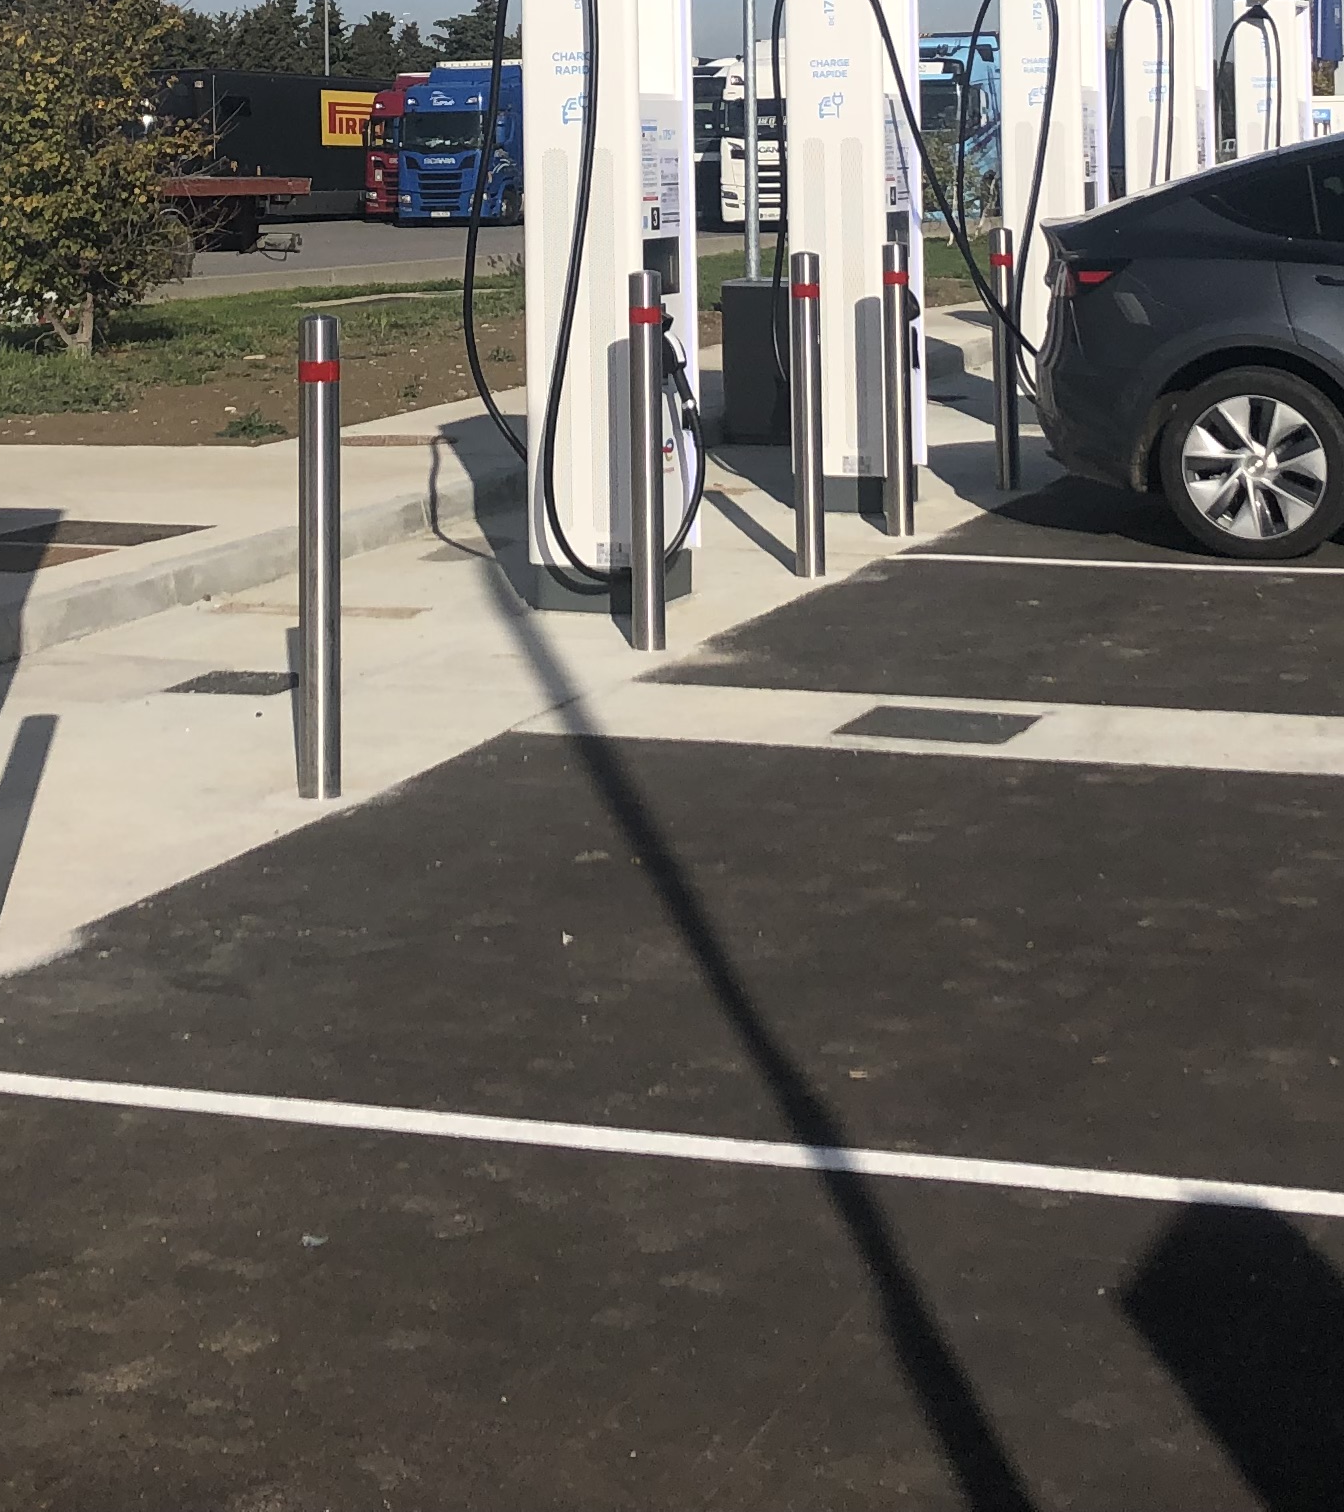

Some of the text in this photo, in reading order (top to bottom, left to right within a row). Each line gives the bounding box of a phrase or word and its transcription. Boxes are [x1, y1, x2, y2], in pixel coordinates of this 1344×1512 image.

[551, 51, 591, 62] CHARG
[810, 58, 850, 68] CHARGE
[555, 65, 591, 76] RAPID
[812, 69, 848, 79] RAPIDE
[652, 209, 659, 227] 3
